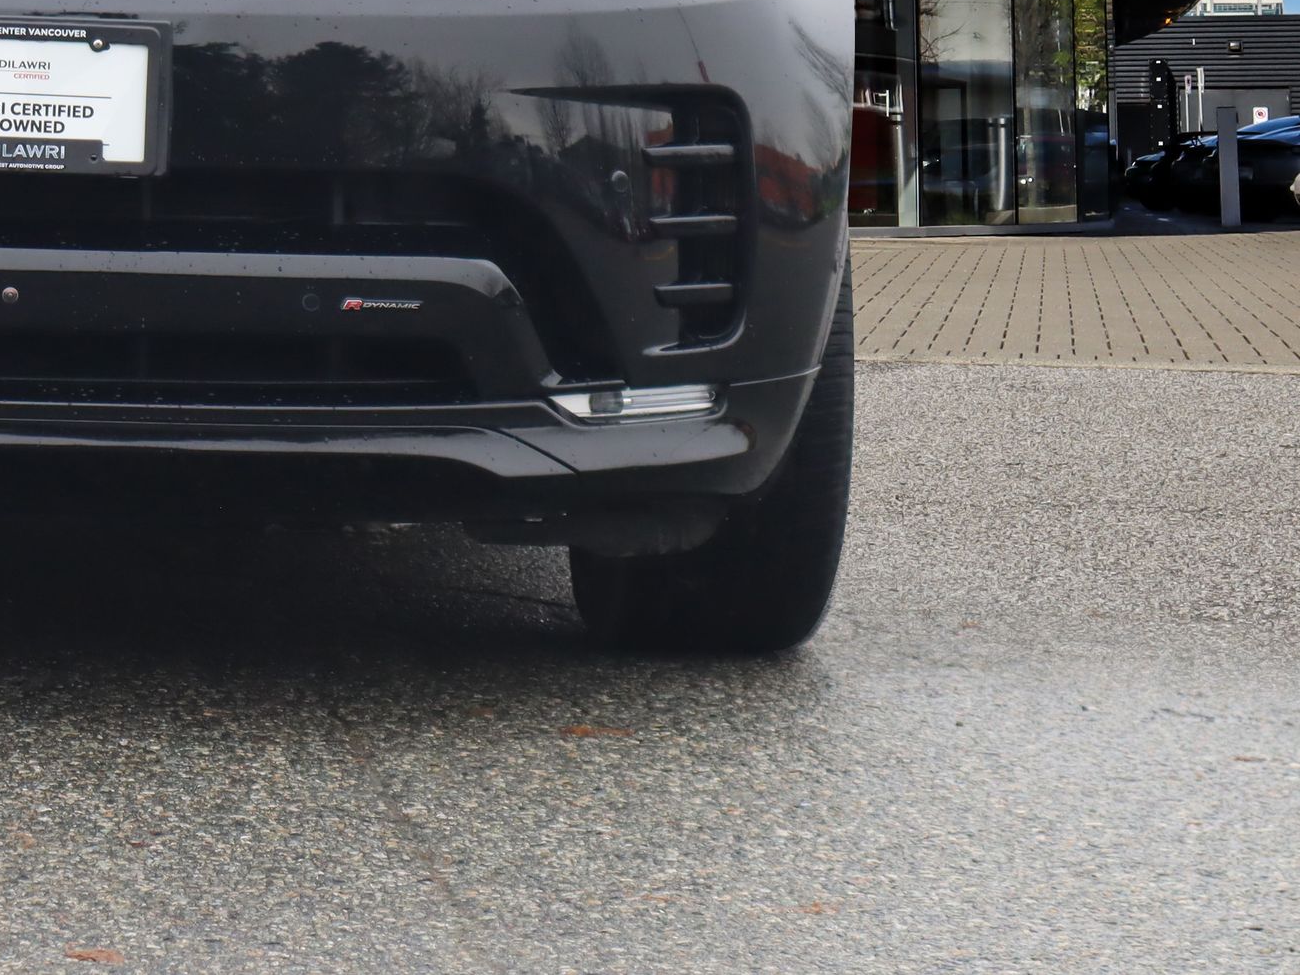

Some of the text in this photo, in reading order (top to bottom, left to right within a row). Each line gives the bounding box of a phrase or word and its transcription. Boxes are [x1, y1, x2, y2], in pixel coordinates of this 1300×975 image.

[28, 28, 87, 38] VANCOUVER
[13, 72, 50, 80] CERTIFIED
[10, 102, 94, 118] CERTIFIED
[363, 301, 421, 310] DYNAMIC
